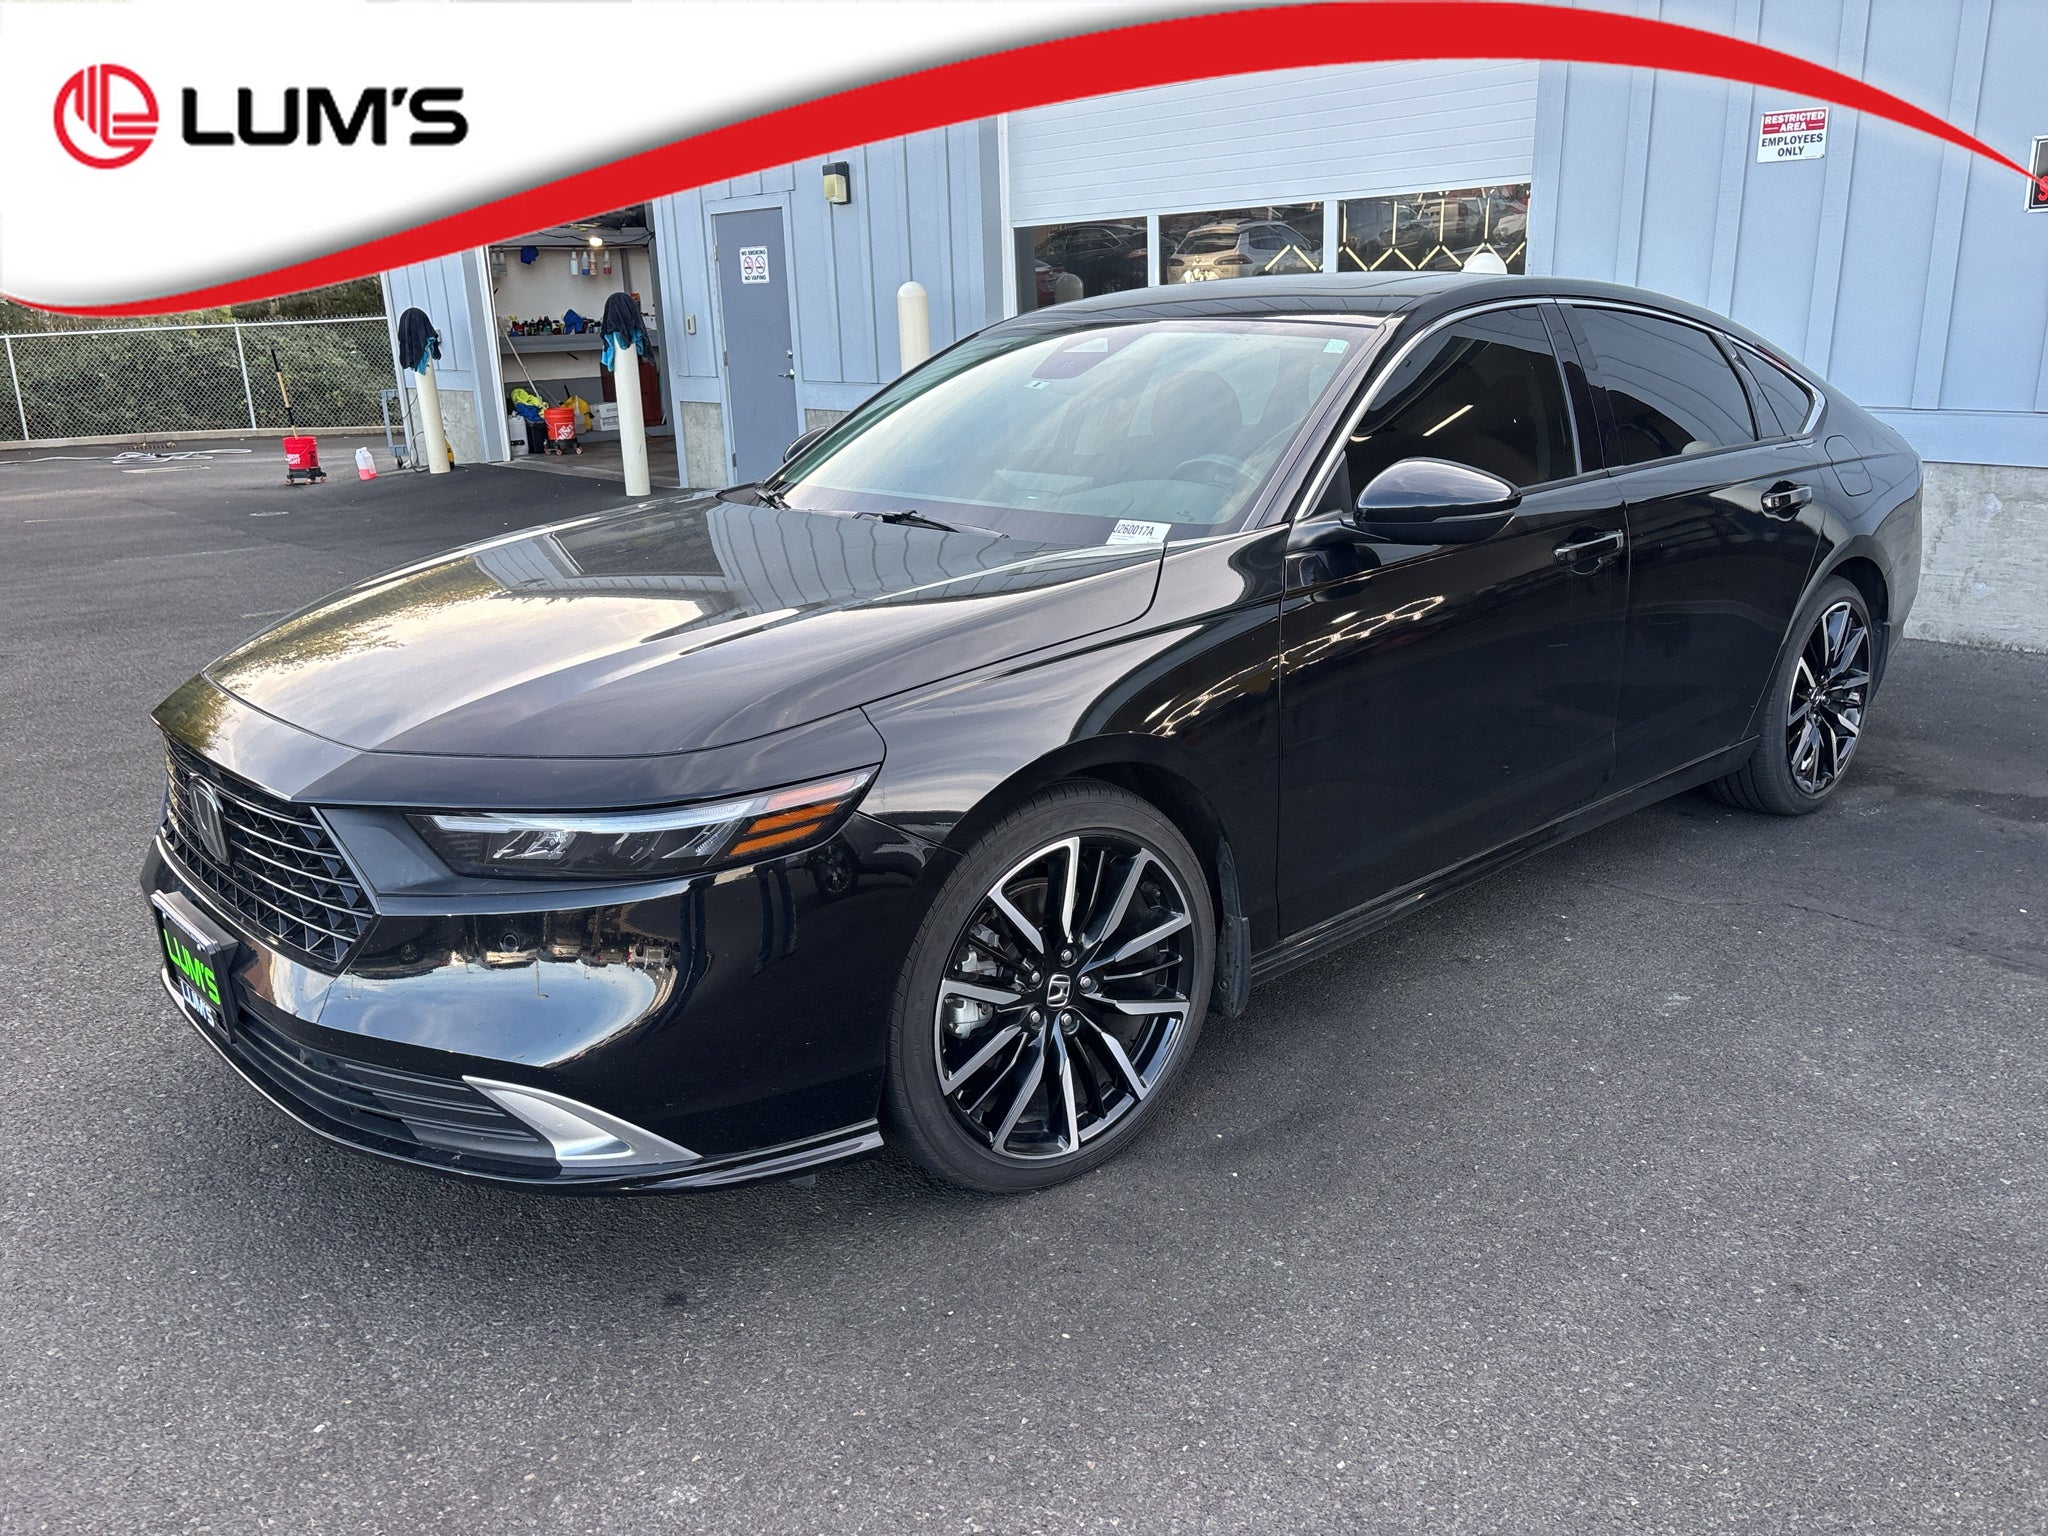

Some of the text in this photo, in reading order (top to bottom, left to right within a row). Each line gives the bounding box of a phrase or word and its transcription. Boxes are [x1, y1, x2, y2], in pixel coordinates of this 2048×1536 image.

[1765, 111, 1824, 124] RESTRICTED
[1780, 122, 1807, 132] AREA
[1761, 133, 1823, 147] EMPLOYEES
[1777, 145, 1805, 157] ONLY
[163, 928, 221, 1006] LUM'S
